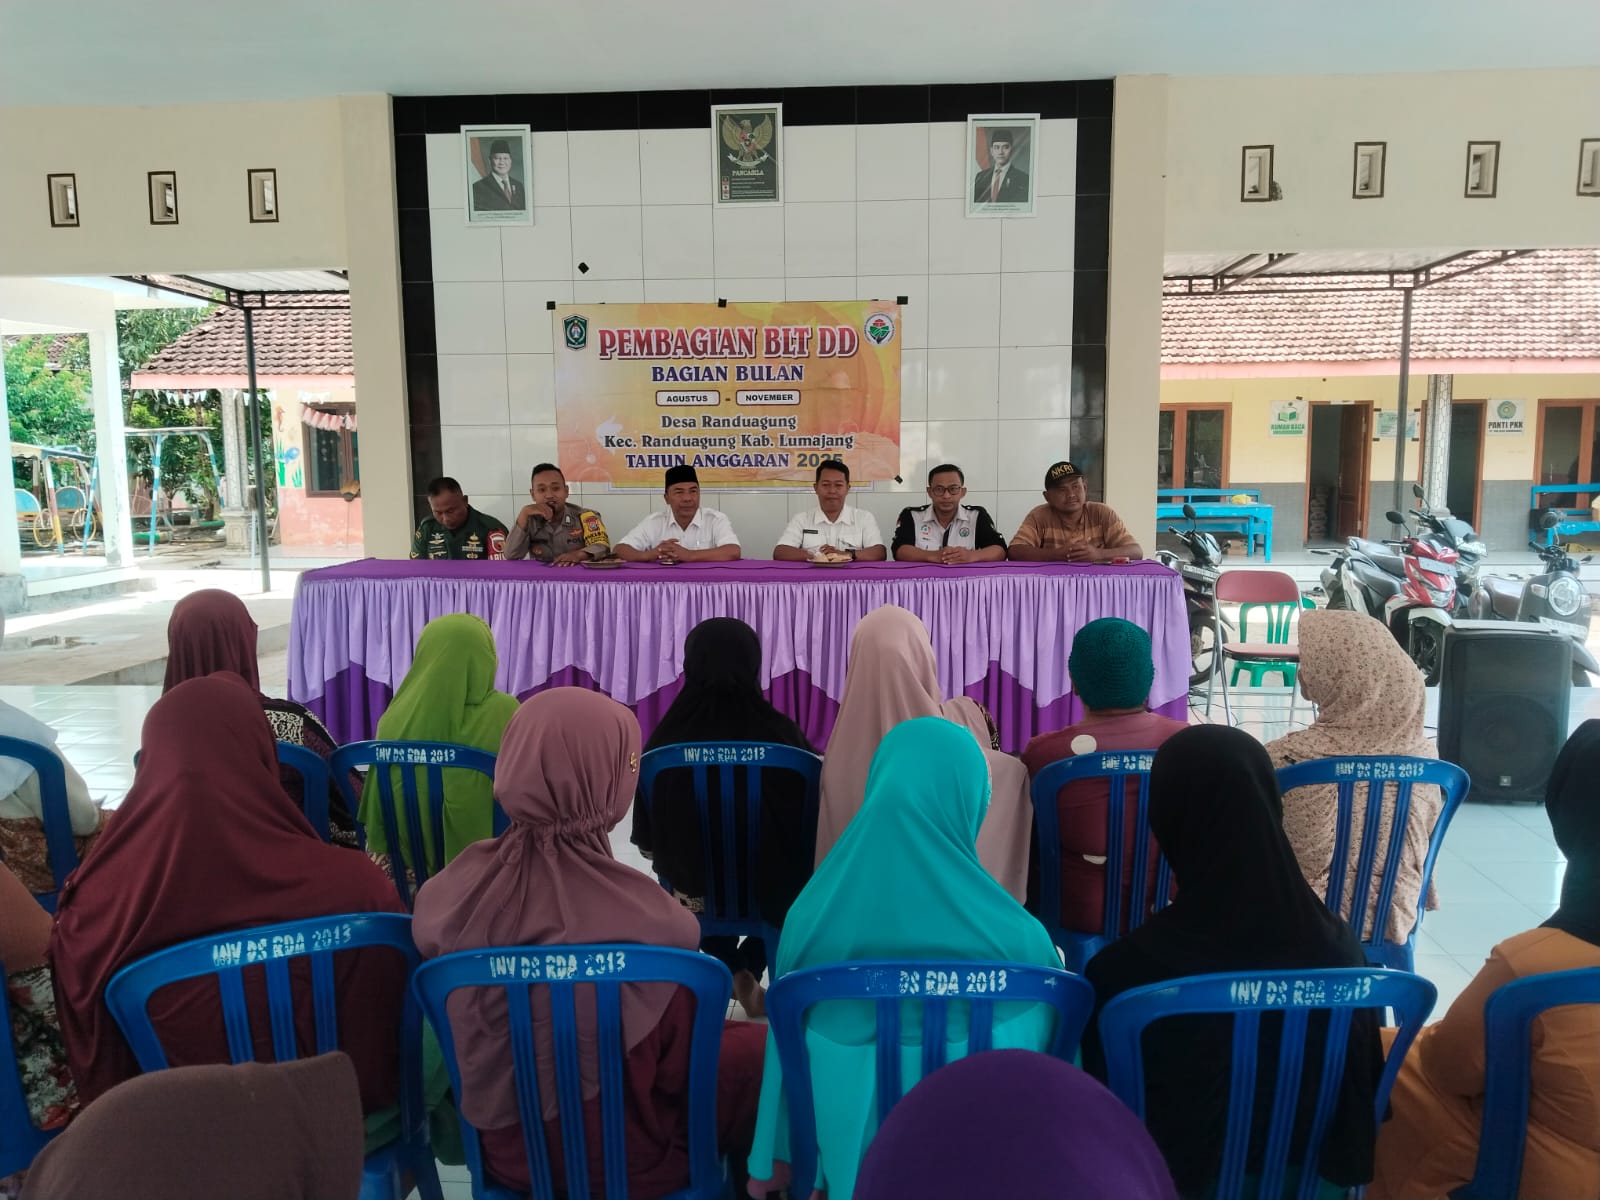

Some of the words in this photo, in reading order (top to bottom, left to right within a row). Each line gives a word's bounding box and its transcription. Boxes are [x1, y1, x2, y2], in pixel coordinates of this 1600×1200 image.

[598, 327, 756, 359] PEMBAGIAN
[763, 327, 811, 358] BLT
[818, 326, 858, 357] DD
[651, 365, 728, 382] BAGIAN
[736, 365, 804, 382] BULAN
[745, 394, 794, 402] NOVEMBER
[661, 415, 697, 428] Desa
[702, 415, 797, 430] Randuagung
[1488, 421, 1508, 429] PANTI
[604, 435, 637, 447] Kec.
[641, 434, 736, 450] Randuagung
[741, 434, 774, 447] Kab.
[779, 434, 853, 449] Lumajang
[625, 454, 686, 468] TAHUN
[692, 453, 789, 468] ANGGARAN
[407, 748, 427, 763] RDA
[430, 749, 456, 763] 2013
[684, 747, 700, 762] INV
[717, 747, 737, 762] RDA
[740, 747, 765, 761] 2013
[247, 938, 267, 961] DS
[272, 933, 305, 958] RDA
[312, 923, 351, 950] 2013
[490, 955, 516, 978] INV
[546, 954, 577, 979] RDA
[925, 970, 959, 995] RDA
[966, 969, 1007, 993] 2013
[1230, 980, 1262, 1004] INV
[1266, 981, 1287, 1005] DS
